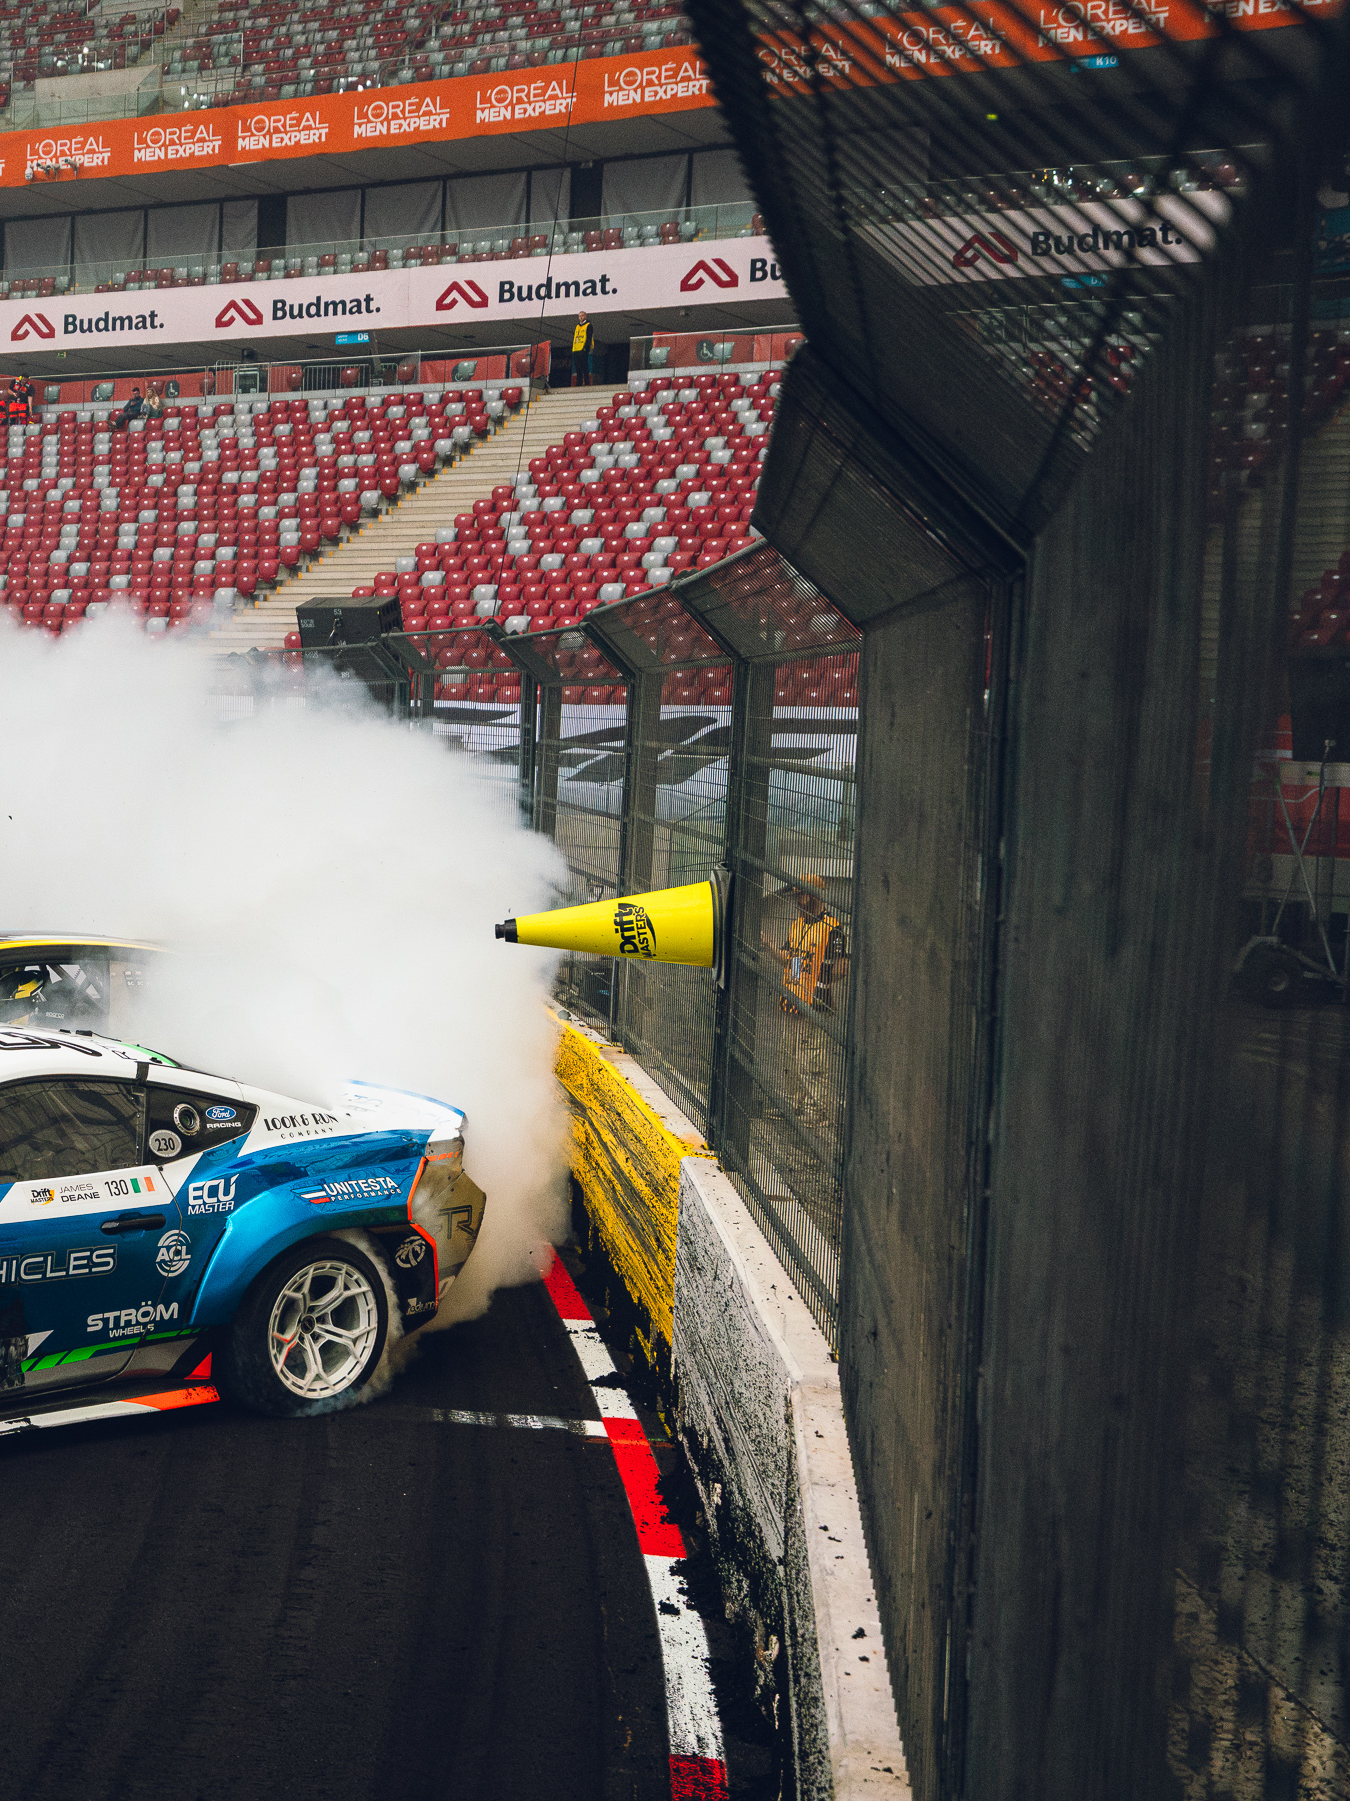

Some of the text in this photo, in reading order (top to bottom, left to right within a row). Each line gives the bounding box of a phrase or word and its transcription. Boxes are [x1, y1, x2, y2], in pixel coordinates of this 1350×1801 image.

[1096, 56, 1117, 66] K10
[605, 61, 707, 91] L'ORÉAL
[477, 80, 577, 109] L'ORÉAL
[604, 80, 709, 107] MEN EXPERT
[354, 96, 450, 123] L'ORÉAL
[476, 97, 576, 123] MEN EXPERT
[134, 124, 221, 148] L'ORÉAL
[238, 111, 328, 138] L'ORÉAL
[354, 113, 449, 138] MEN EXPERT
[27, 136, 111, 160] L'ORÉAL
[134, 140, 221, 162] MEN EXPERT
[238, 128, 328, 151] MEN EXPERT
[1031, 222, 1182, 257] Budmat.
[498, 275, 618, 303] Budmat.
[272, 294, 381, 321] Budmat.
[63, 310, 164, 334] Budmat.
[357, 332, 369, 341] D6
[613, 908, 640, 954] Drift
[206, 1121, 242, 1129] RACING
[264, 1115, 300, 1132] LOOK
[312, 1112, 339, 1126] RUN
[281, 1127, 334, 1139] COMPANY
[155, 1137, 176, 1152] 230
[31, 1188, 52, 1198] Drift
[59, 1183, 94, 1194] JAMES
[61, 1191, 100, 1203] DEANE
[104, 1179, 129, 1197] 130
[188, 1173, 239, 1206] ECU
[323, 1176, 399, 1196] UNITESTA
[331, 1188, 402, 1202] PERFORMANCE
[187, 1200, 234, 1215] MASTER
[155, 1245, 191, 1262] ACL
[86, 1300, 179, 1332] STRÖM
[109, 1323, 155, 1338] WHEELS
